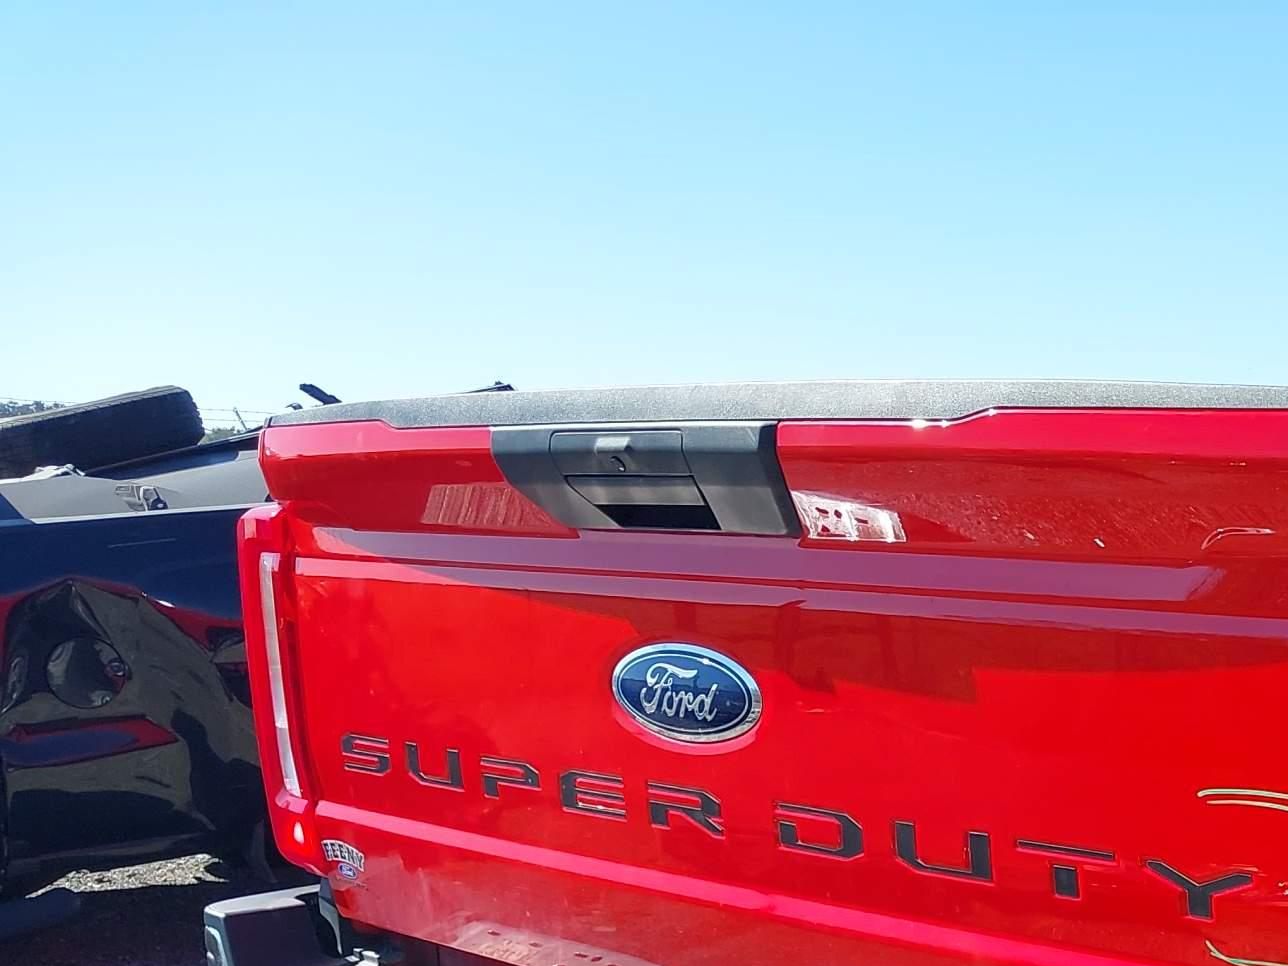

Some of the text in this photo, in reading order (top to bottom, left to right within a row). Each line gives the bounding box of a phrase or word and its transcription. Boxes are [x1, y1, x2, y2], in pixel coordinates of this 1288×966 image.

[640, 663, 718, 722] Ford
[322, 840, 364, 872] FEENY
[341, 732, 1254, 921] SUPER DUTY
